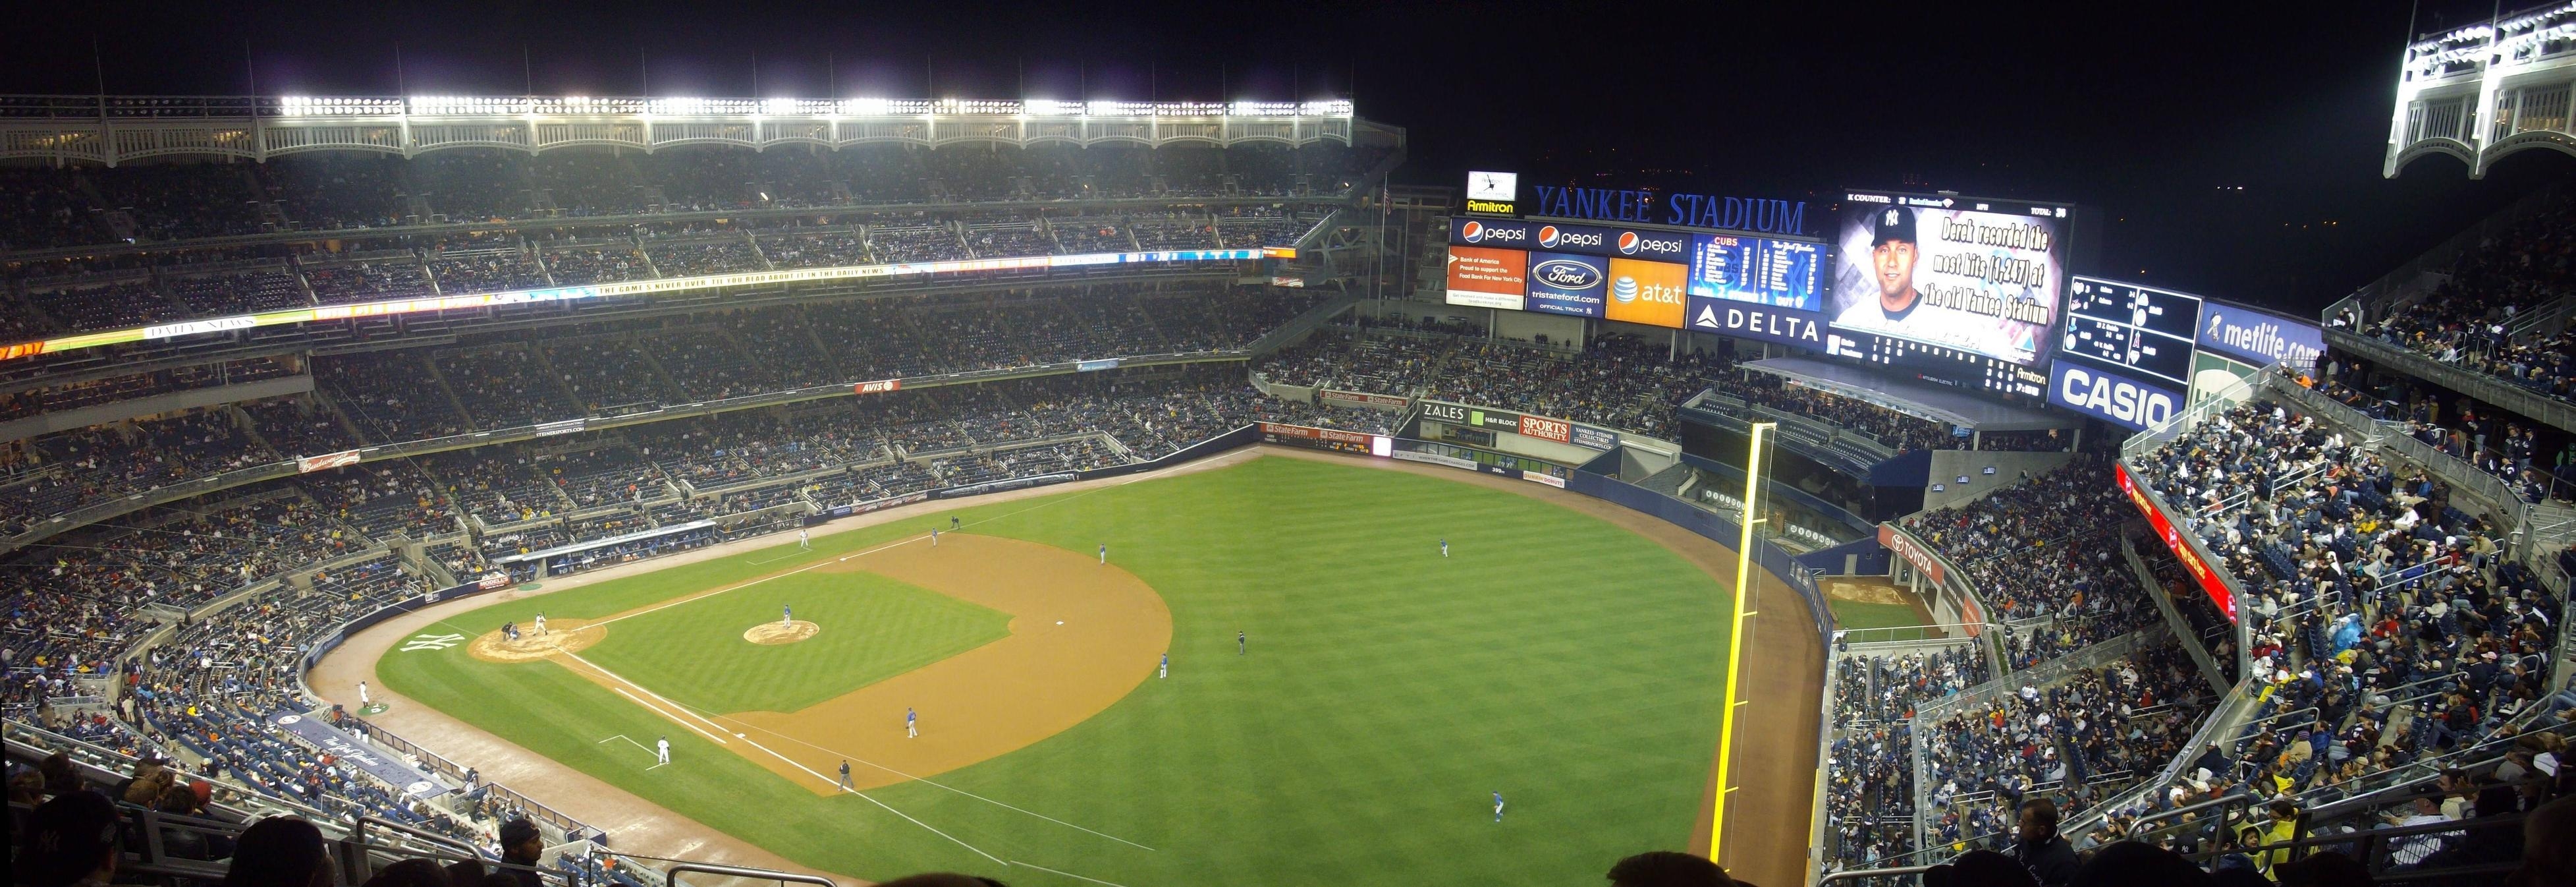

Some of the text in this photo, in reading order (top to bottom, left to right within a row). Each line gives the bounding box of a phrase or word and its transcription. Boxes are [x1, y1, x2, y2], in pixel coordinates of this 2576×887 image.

[1467, 200, 1513, 213] Armitron
[1535, 186, 1805, 235] YANKEE STADIUM
[1485, 228, 1525, 241] pepsi
[1561, 233, 1601, 246] pepsi
[1714, 237, 1738, 246] CUBS
[1942, 217, 2048, 251] Derek recorded the
[1641, 239, 1682, 254] pepsi
[1548, 265, 1587, 284] Ford
[1934, 253, 2044, 289] most hits (1,247) at
[1532, 291, 1600, 304] tristateford.com
[1642, 283, 1682, 305] at&t
[1924, 283, 2048, 326] the old Yankee Stadium
[1728, 308, 1818, 341] DELTA
[2224, 322, 2320, 368] metlife.com
[2017, 368, 2045, 385] Armitron
[862, 383, 883, 392] AVIS
[2063, 369, 2172, 434] CASIO
[1424, 404, 1464, 420] ZALES
[1498, 418, 1517, 426] BLOCK
[1523, 418, 1567, 434] SPORTS
[536, 427, 584, 437] STEINERSPORTS.COM
[1274, 424, 1307, 436] State Farm
[1329, 431, 1363, 442] State Farm
[1579, 434, 1609, 443] COLLECTIBLES
[302, 453, 348, 473] Budweiser
[1544, 478, 1562, 486] DONUTS
[1905, 541, 1932, 575] TOYOTA
[480, 577, 508, 586] MODELL'S
